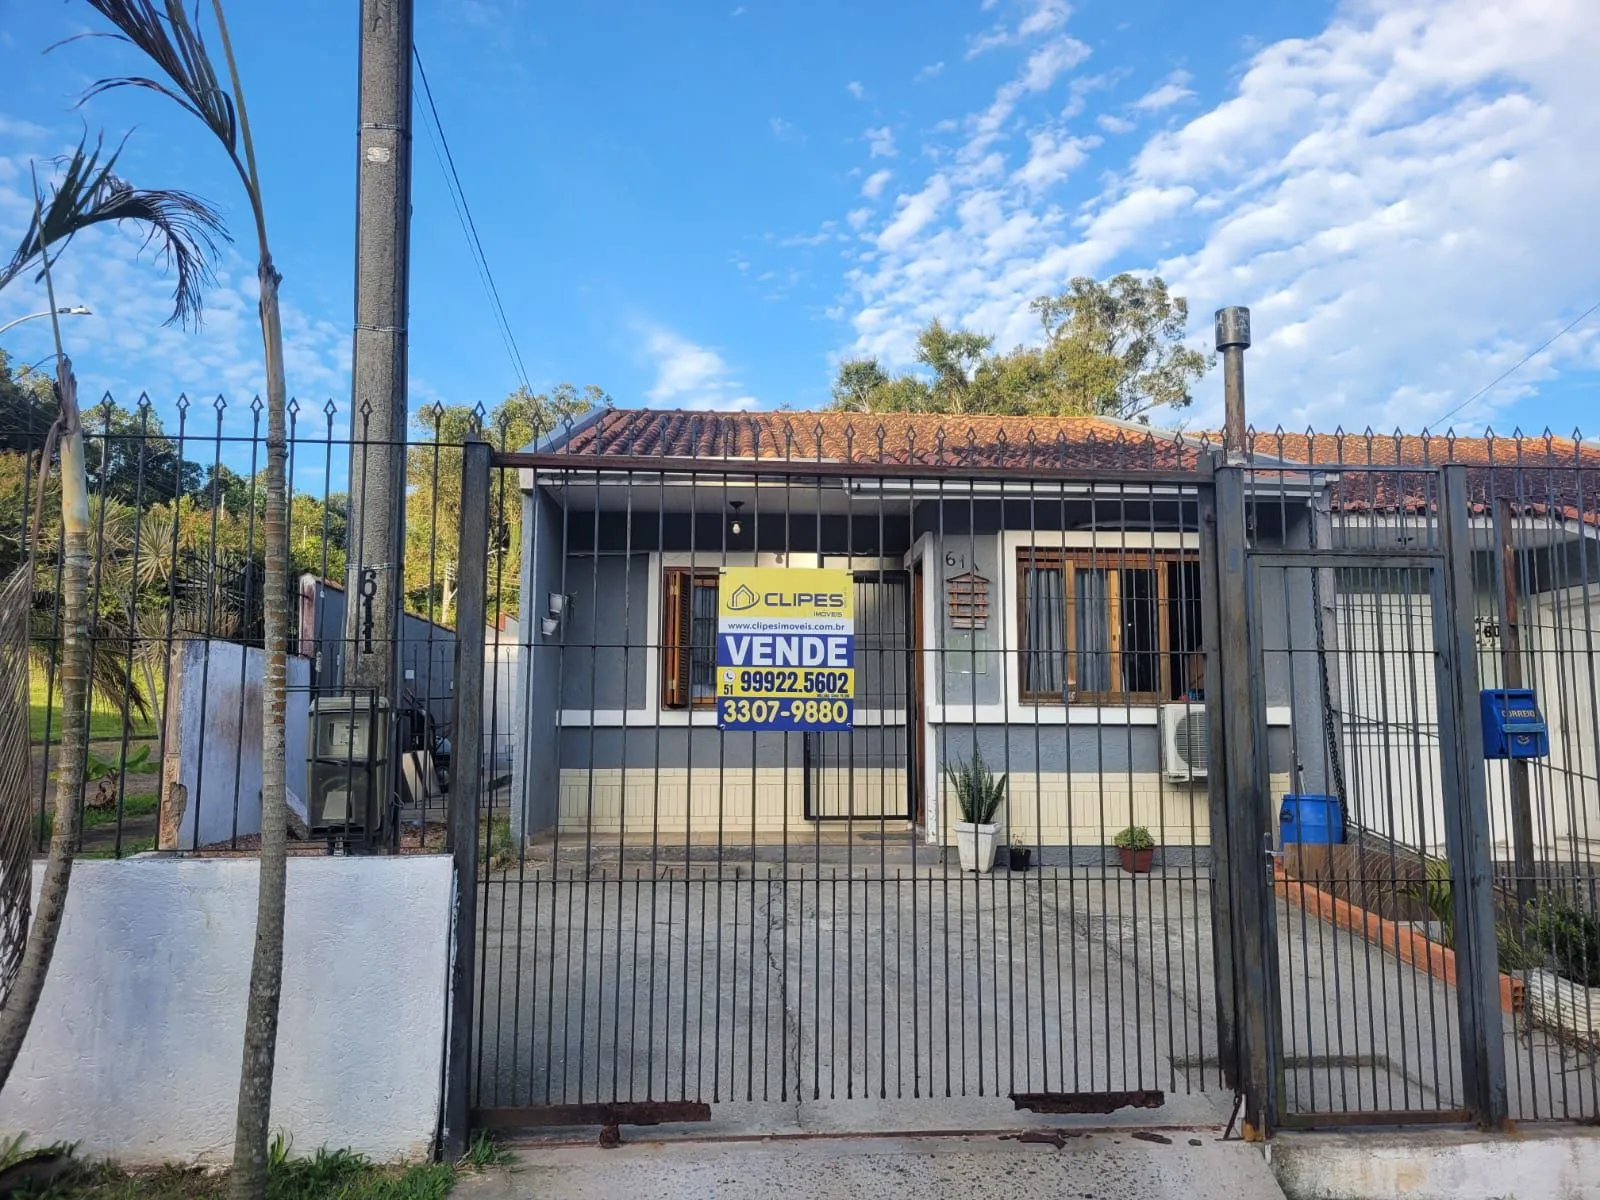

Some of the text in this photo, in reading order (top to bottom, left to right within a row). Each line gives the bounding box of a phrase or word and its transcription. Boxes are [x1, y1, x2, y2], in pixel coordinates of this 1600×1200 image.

[361, 569, 377, 654] 611
[764, 593, 843, 607] CLIPES
[728, 622, 845, 631] www.clipesimoveis.com.br
[725, 636, 848, 667] VENDE
[723, 671, 849, 695] 51 99922.5602
[723, 699, 848, 724] 3307-9880
